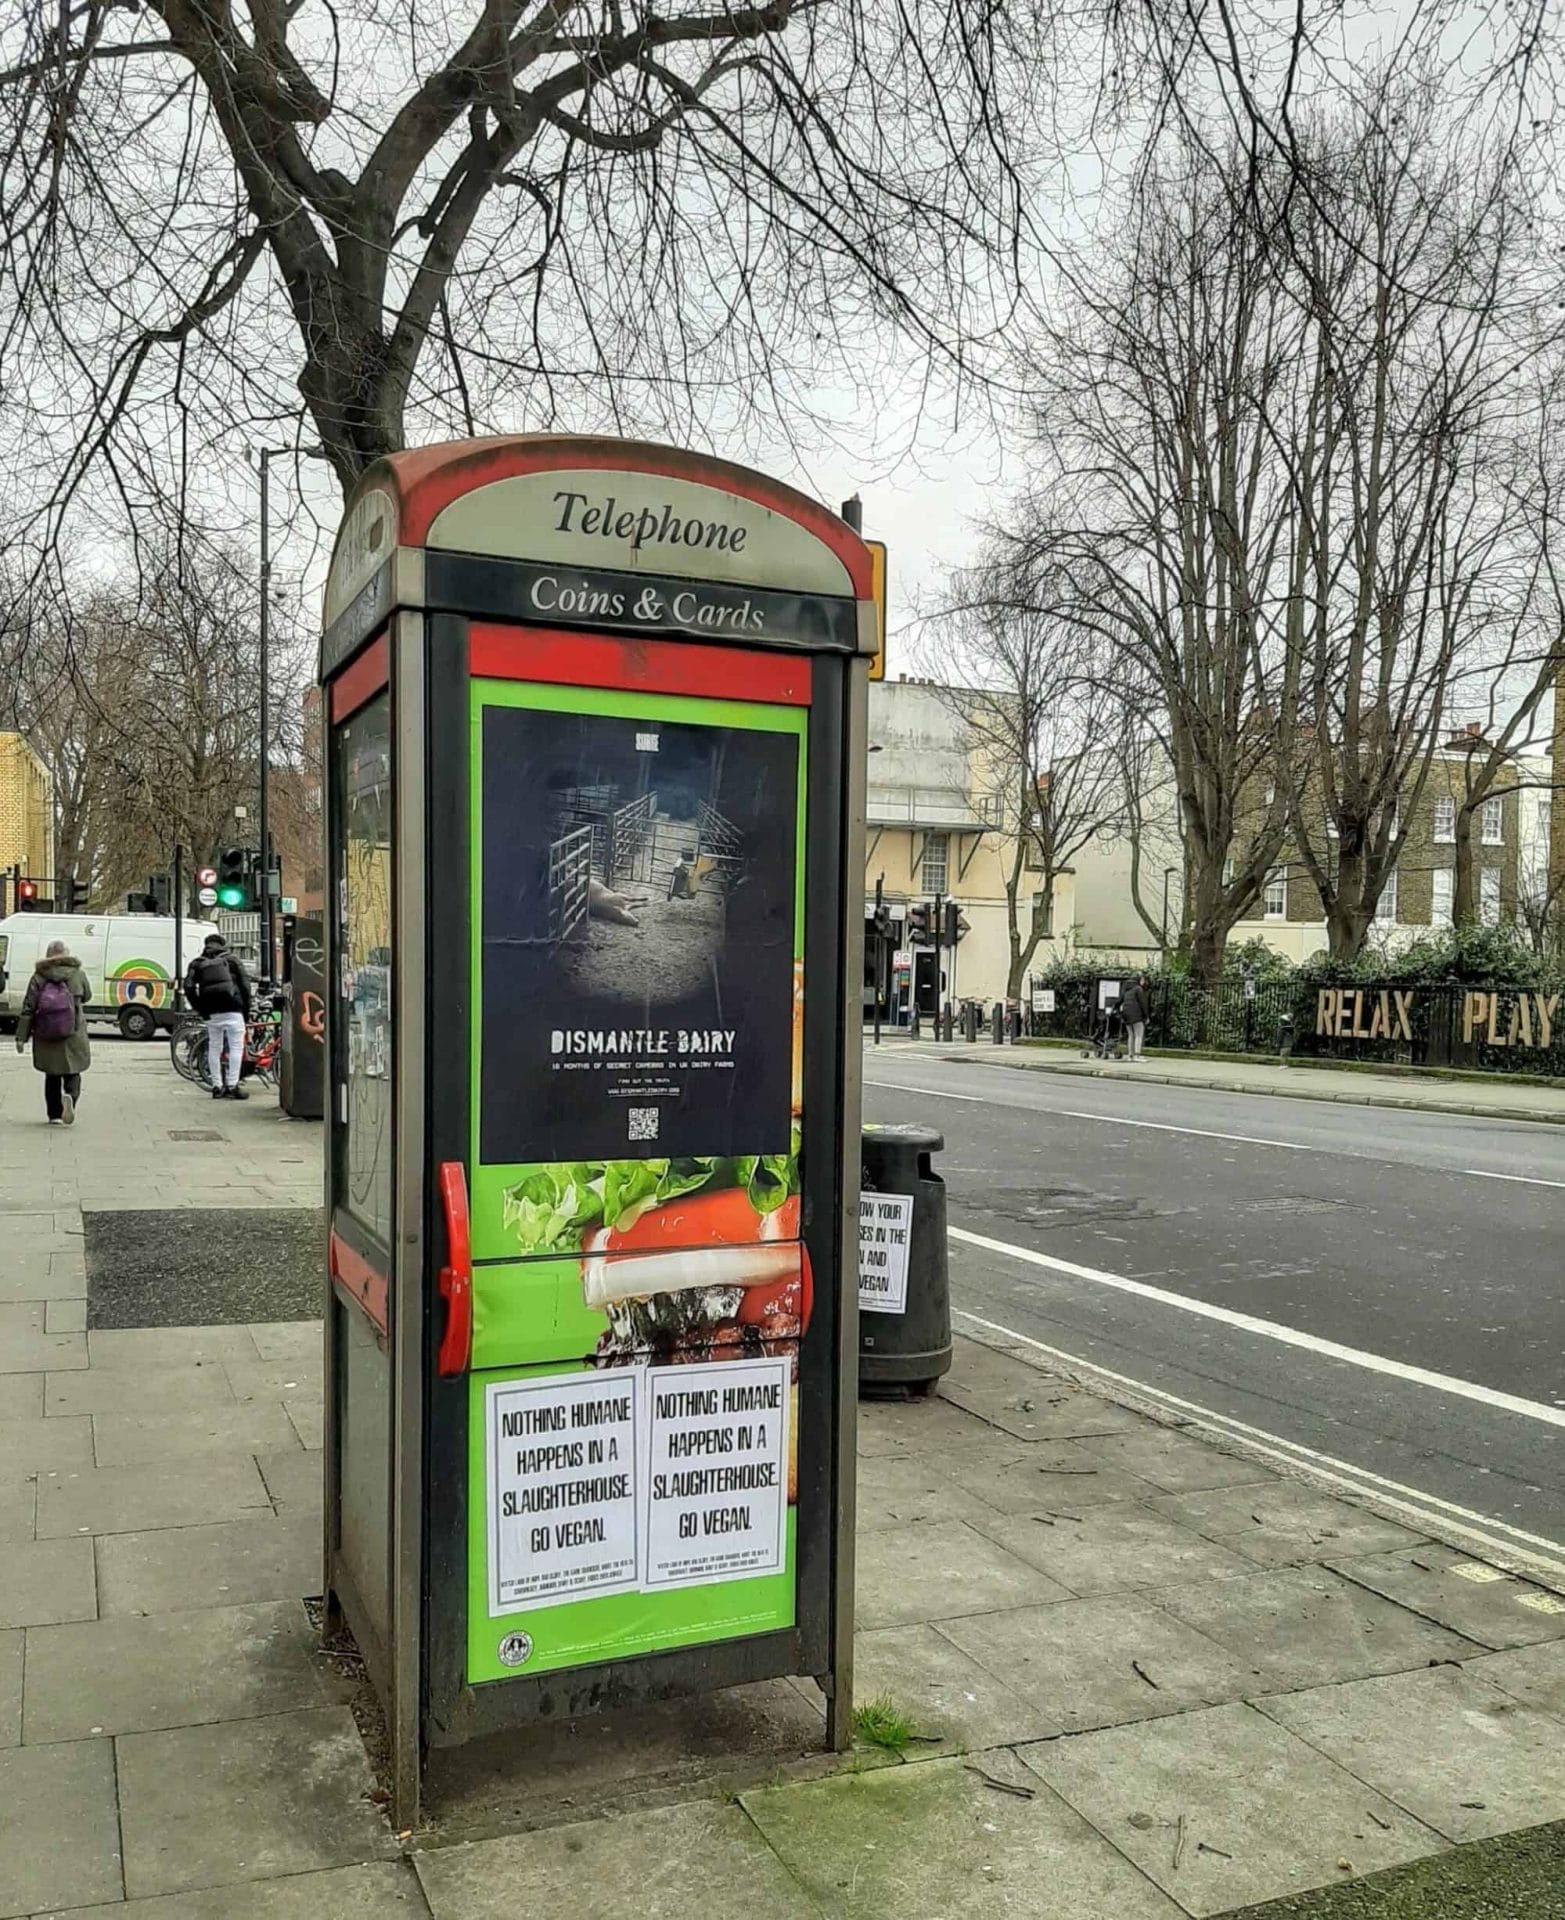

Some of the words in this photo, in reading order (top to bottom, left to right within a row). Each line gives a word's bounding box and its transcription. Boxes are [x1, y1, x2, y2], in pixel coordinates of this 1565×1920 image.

[553, 491, 748, 553] Telephone
[530, 576, 626, 618] Coins
[633, 588, 664, 621] &
[672, 592, 766, 631] Cards
[1316, 989, 1415, 1041] RELAX
[1463, 992, 1560, 1048] PLAY
[550, 1030, 670, 1054] DISMANTLE
[677, 1030, 736, 1053] DAIRY
[878, 1203, 902, 1220] YOUR
[876, 1227, 886, 1243] IN
[889, 1228, 907, 1245] THE
[867, 1250, 887, 1267] AND
[859, 1274, 889, 1292] VEGAN
[503, 1405, 566, 1438] NOTHING
[571, 1397, 631, 1428] HUMANE
[656, 1389, 718, 1420] NOTHING
[722, 1384, 781, 1413] HUMANE
[517, 1442, 583, 1475] HAPPENS
[588, 1439, 603, 1464] IN
[609, 1437, 618, 1461] A
[669, 1427, 733, 1458] HAPPENS
[738, 1426, 752, 1450] IN
[757, 1424, 766, 1449] A
[503, 1474, 632, 1517] SLAUGHTERHOUSE.
[653, 1462, 779, 1500] SLAUGHTERHOUSE.
[531, 1526, 550, 1553] GO
[555, 1517, 607, 1549] VEGAN.
[679, 1512, 697, 1539] GO
[703, 1506, 752, 1535] VEGAN.
